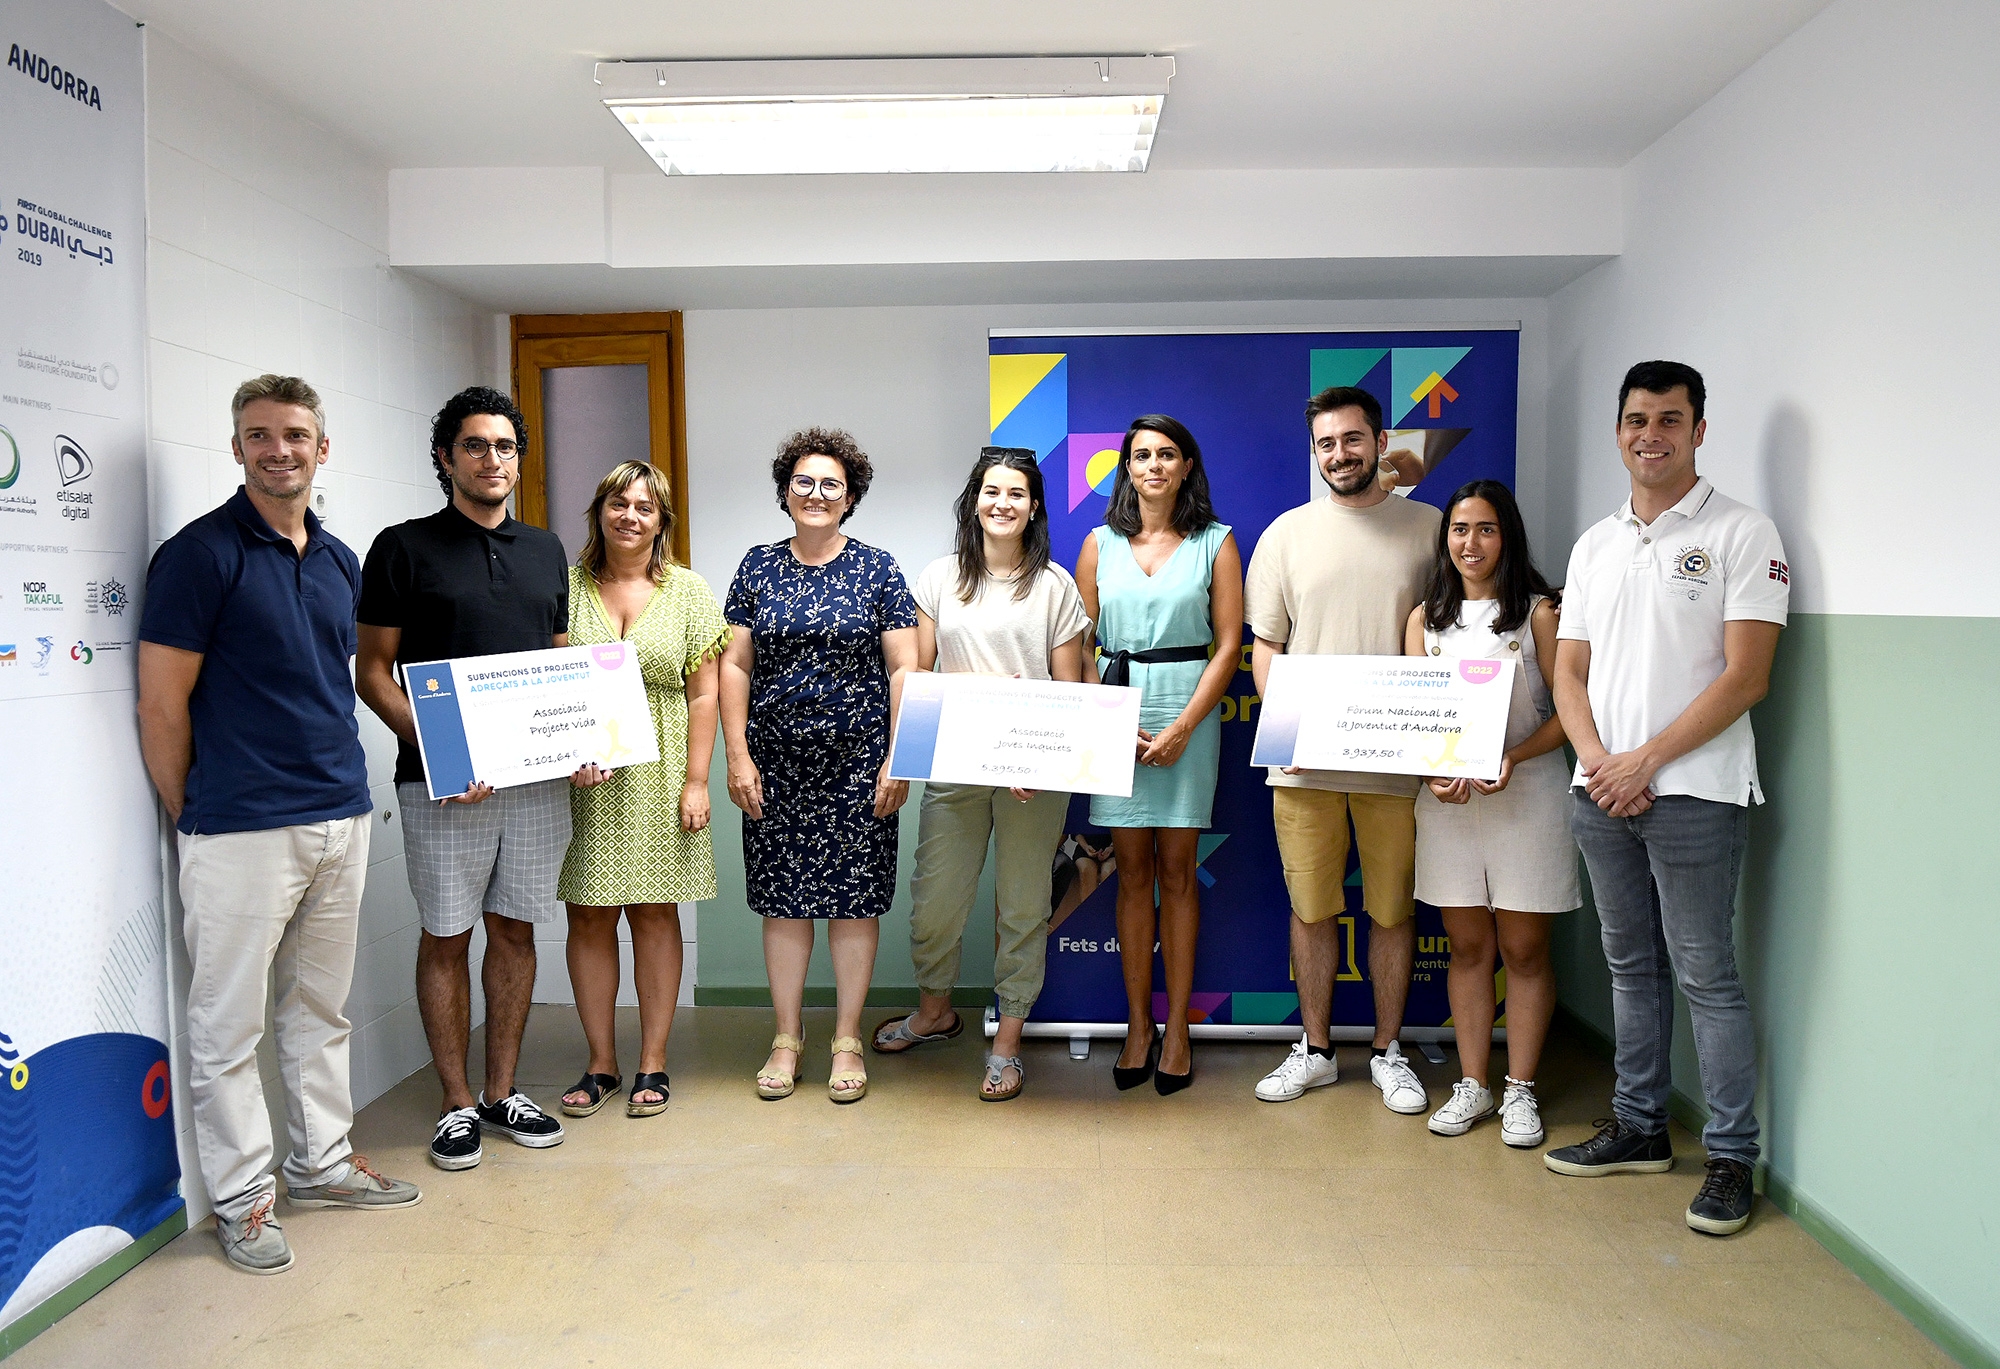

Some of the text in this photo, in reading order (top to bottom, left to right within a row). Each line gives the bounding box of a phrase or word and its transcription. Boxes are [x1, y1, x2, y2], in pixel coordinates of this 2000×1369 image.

[7, 43, 102, 112] ANDORRA
[17, 198, 112, 240] FIRST GLOBAL CHALLENGE
[17, 213, 64, 249] DUBAI
[18, 248, 42, 266] 2019
[18, 358, 98, 383] DUBAI FUTURE FOUNDATION
[2, 394, 52, 411] MAIN PARTNERS
[56, 489, 93, 504] etisalat
[61, 505, 91, 521] digital
[37, 545, 69, 554] PARTNERS
[23, 581, 47, 593] NOOR
[24, 593, 63, 605] TAKAFUL
[467, 660, 590, 682] SUBVENCIONS DE PROJECTES
[1386, 669, 1398, 678] DE
[1400, 669, 1452, 680] PROJECTES
[1466, 664, 1494, 676] 2022
[470, 671, 591, 693] ADREÇATS A LA JOVENTUT
[1382, 679, 1394, 687] LA
[1397, 680, 1450, 689] JOVENTUT
[1035, 692, 1084, 703] PROJECTES
[532, 700, 588, 719] Associació
[1346, 704, 1458, 719] Fòrum Nacional de
[529, 721, 570, 738] Projecte
[1008, 727, 1065, 739] Associació
[1336, 719, 1463, 735] la Joventut d'Andorra
[993, 740, 1023, 750] Joves
[523, 752, 571, 767] 2.101,64
[1342, 747, 1395, 761] 3.937,50
[1397, 748, 1405, 759] €
[1059, 937, 1099, 953] Fets
[1414, 959, 1450, 969] ventu
